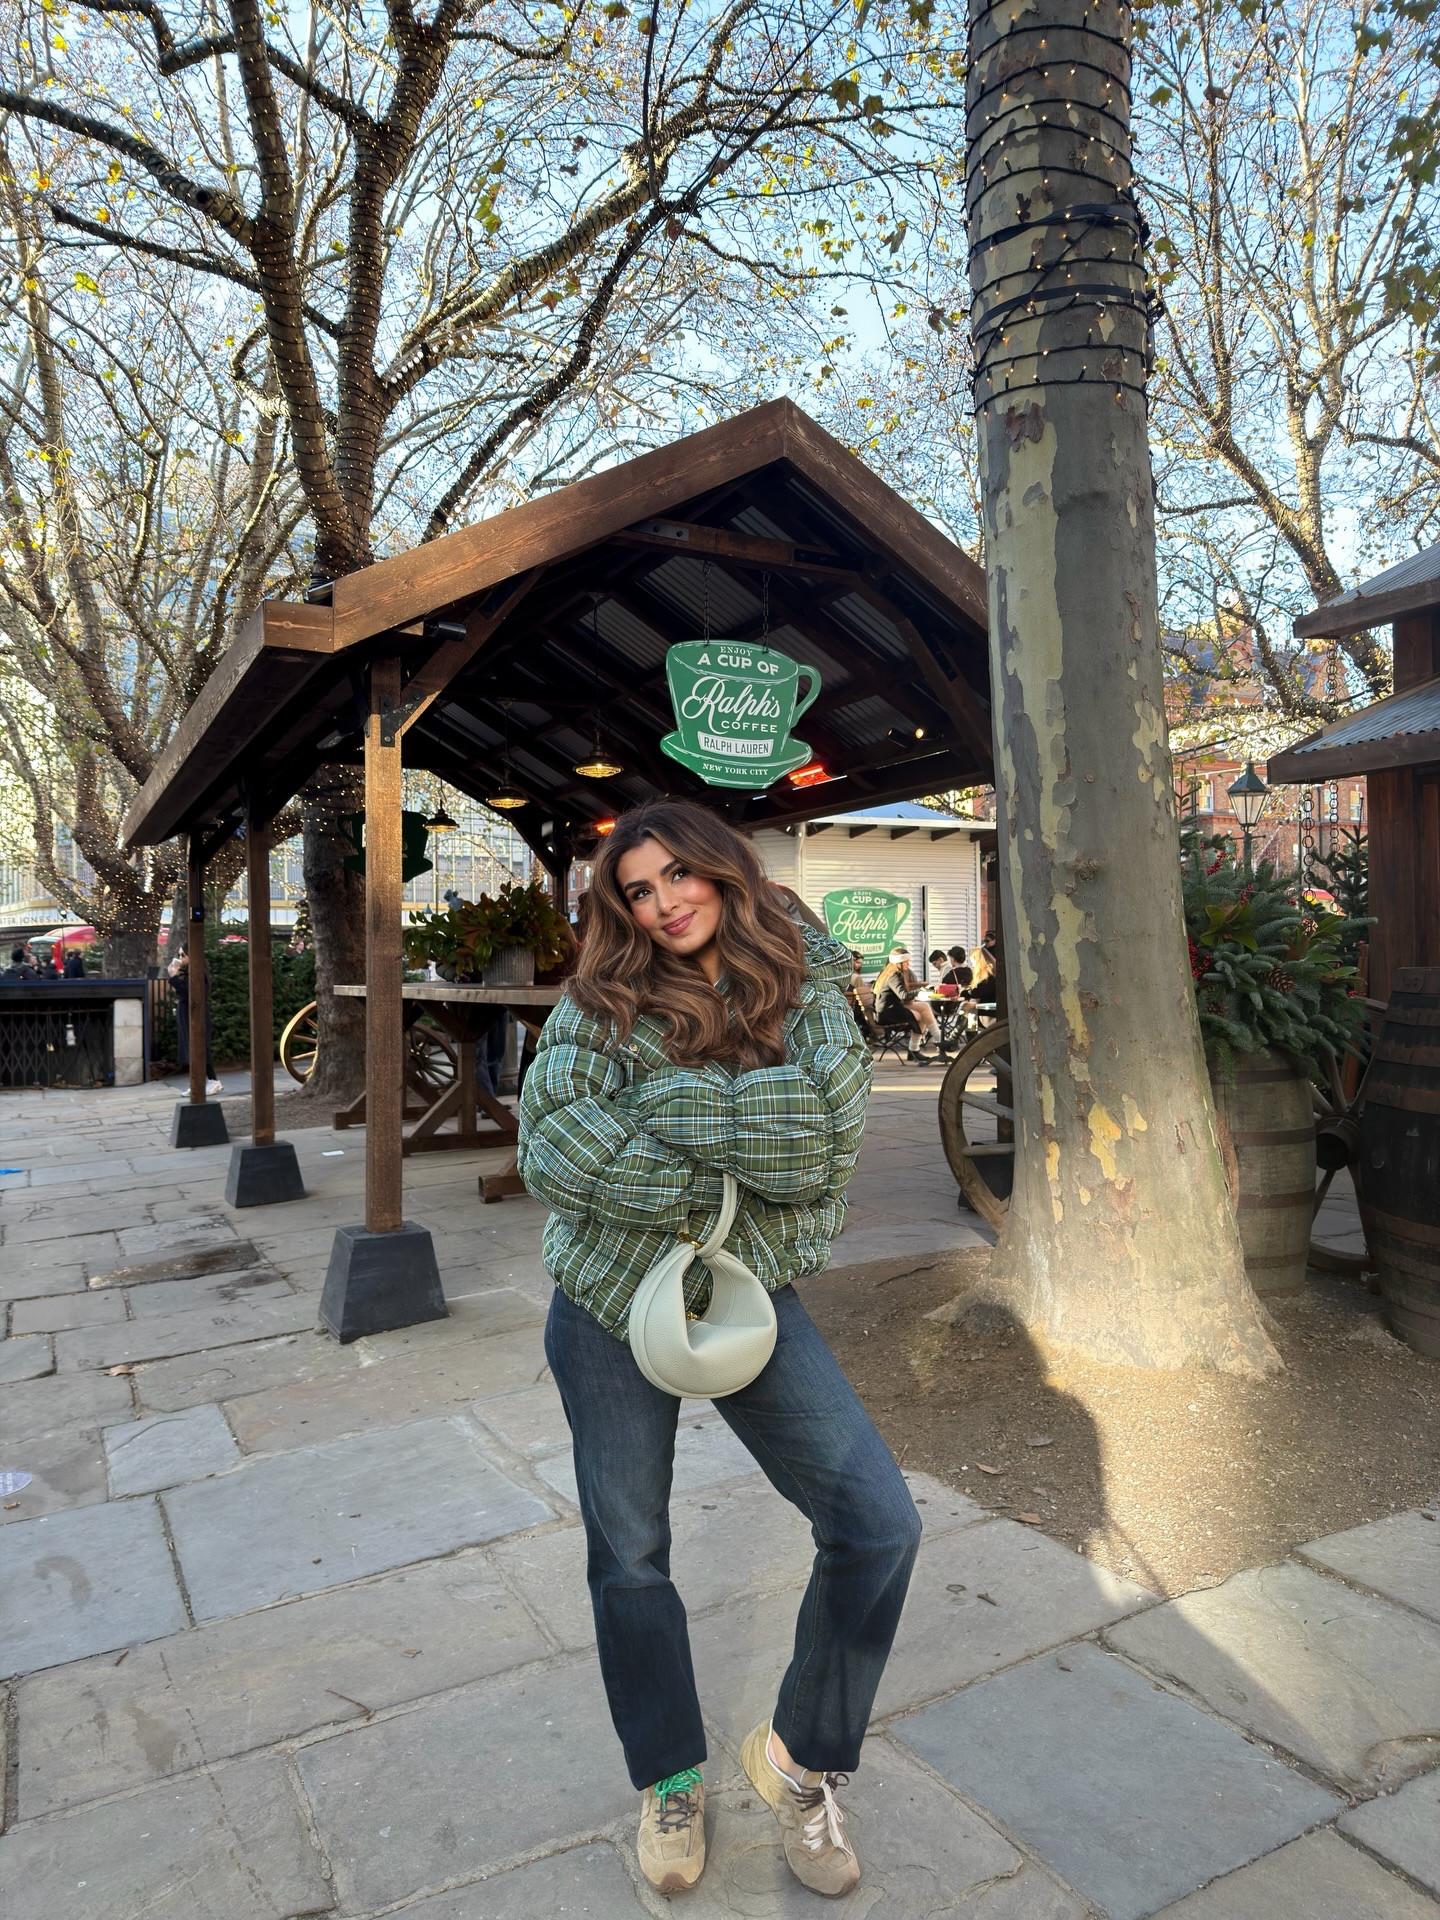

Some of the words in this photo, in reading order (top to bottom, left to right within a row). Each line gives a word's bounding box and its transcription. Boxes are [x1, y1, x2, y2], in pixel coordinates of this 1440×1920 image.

[720, 646, 752, 656] ENJOY
[697, 653, 711, 666] A
[717, 654, 752, 669] CUP
[757, 661, 779, 676] OF
[681, 676, 780, 735] Ralph's
[721, 720, 778, 733] COFFEE
[704, 737, 732, 753] RALPH
[735, 740, 769, 754] LAUREN
[702, 763, 722, 772] NEW
[725, 767, 747, 775] YORK
[841, 896, 849, 904] A
[852, 896, 872, 904] CUP
[874, 898, 887, 906] OF
[832, 909, 888, 942] Ralph's
